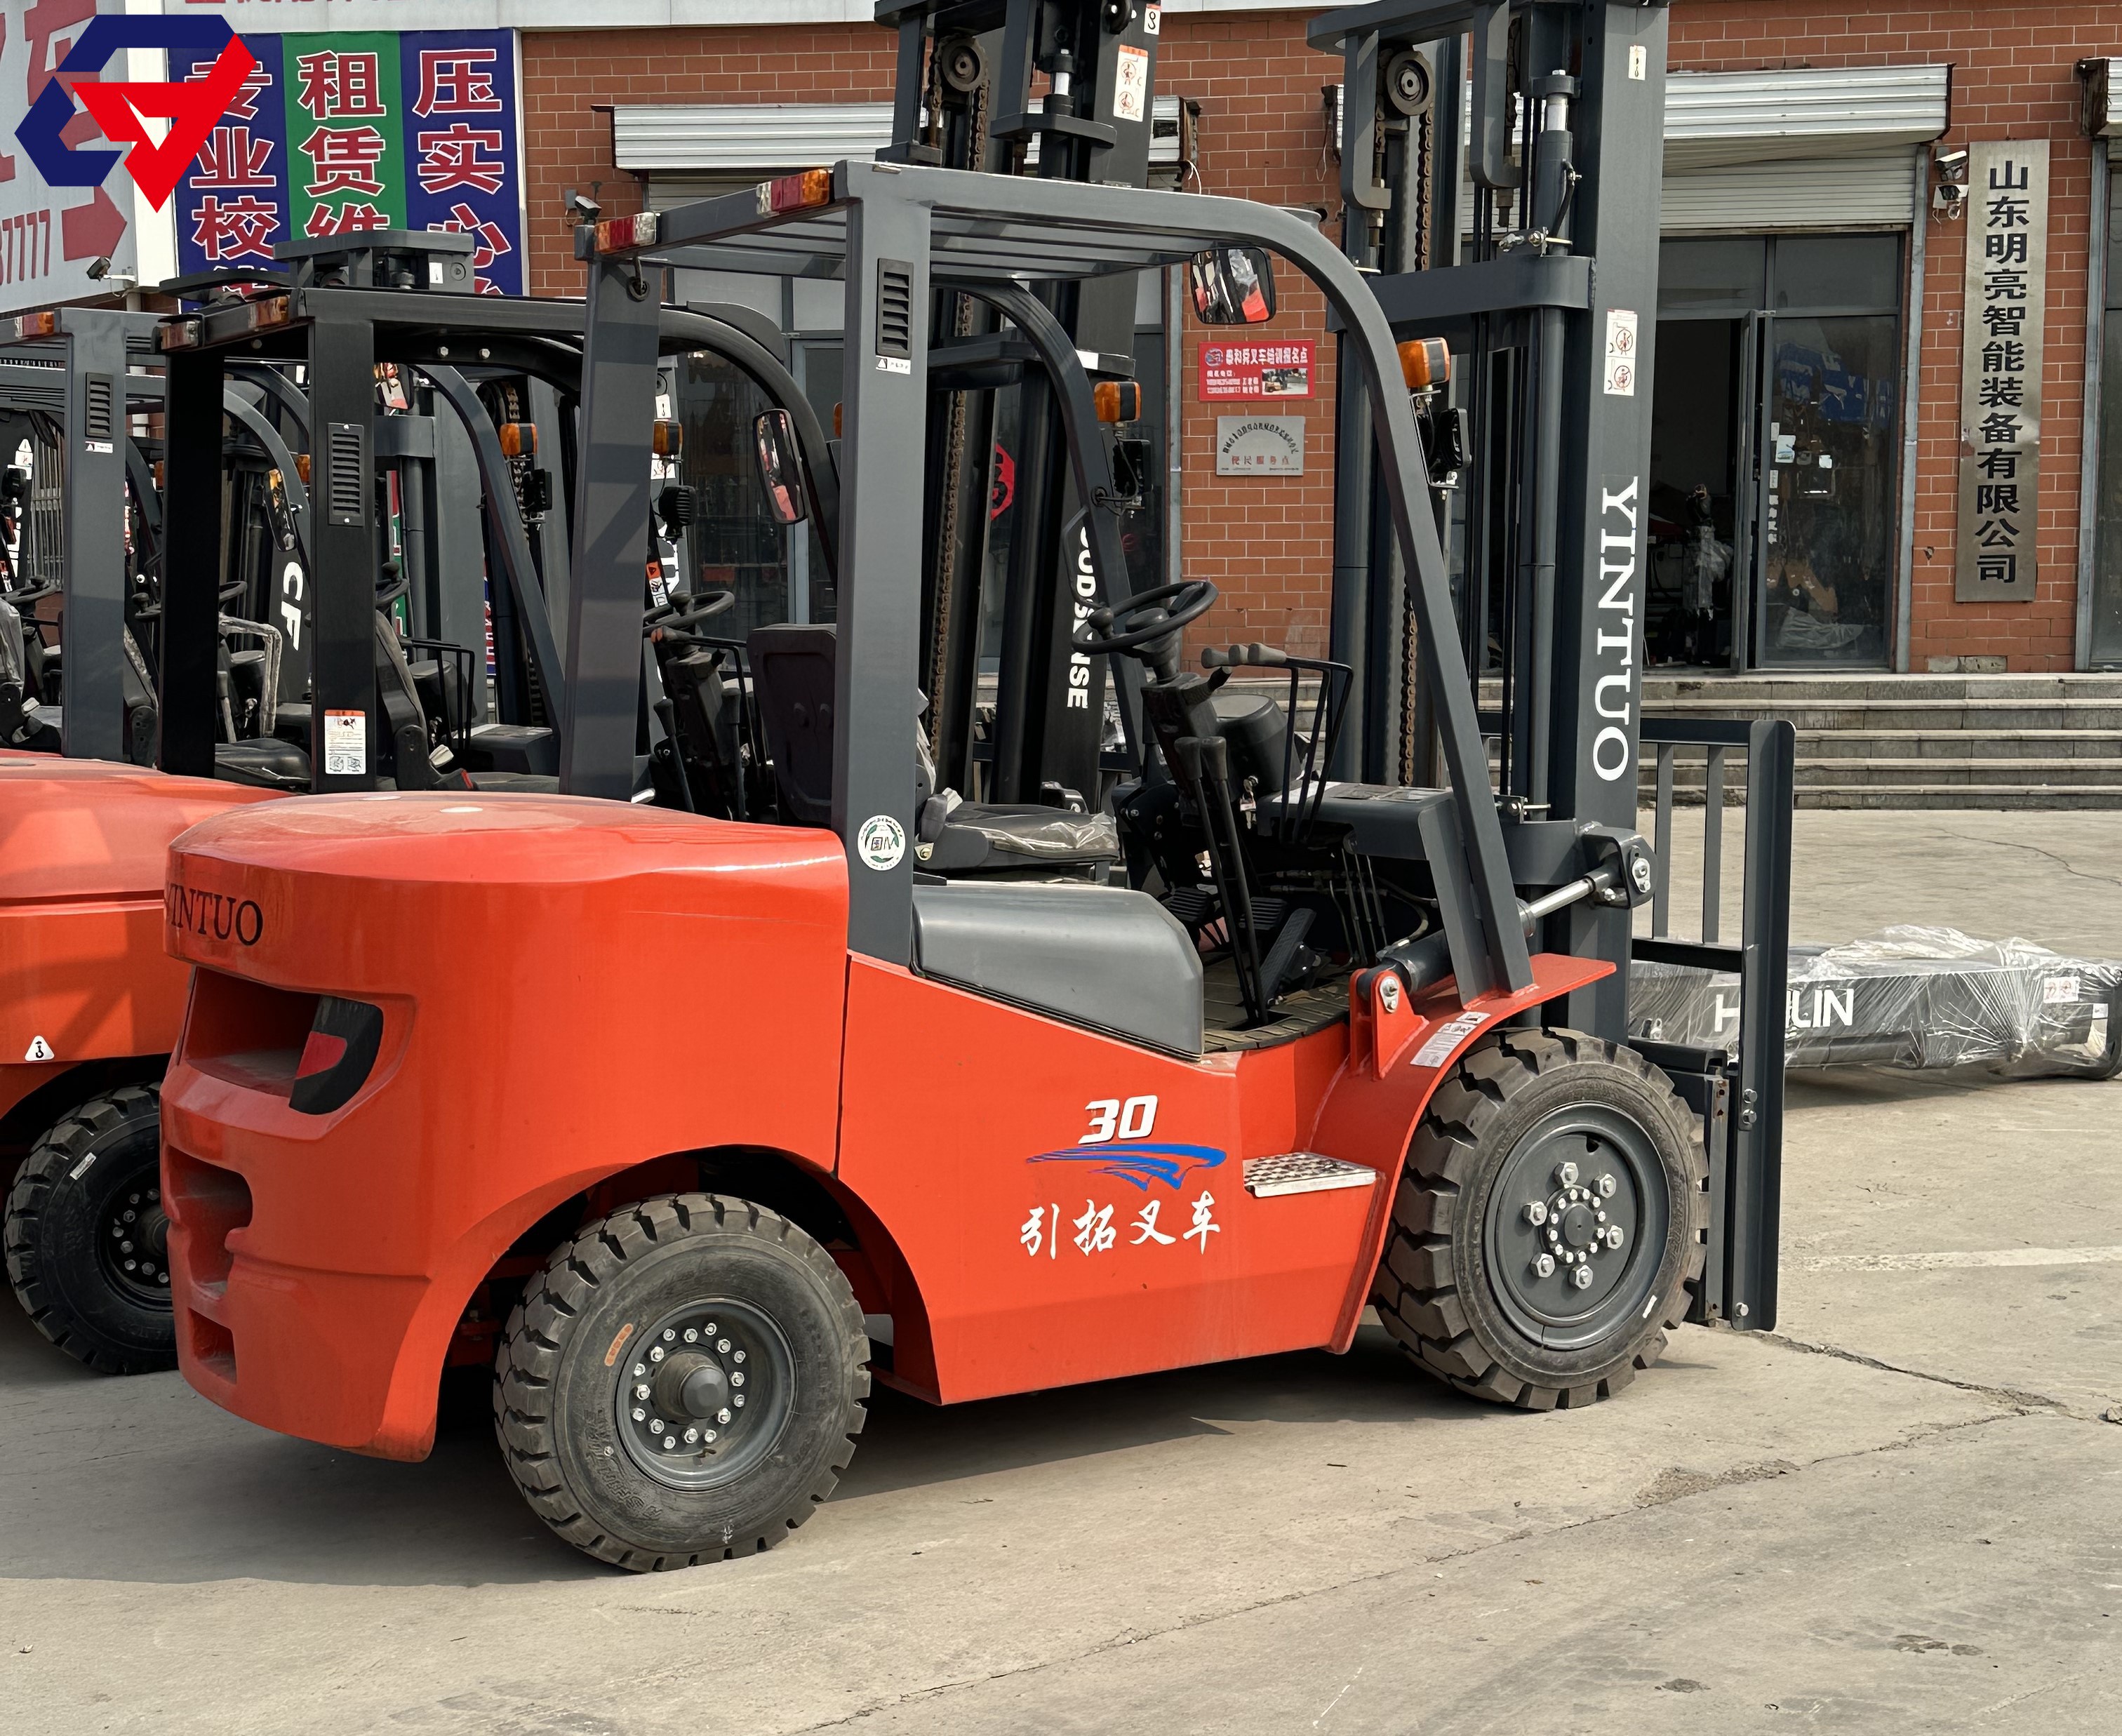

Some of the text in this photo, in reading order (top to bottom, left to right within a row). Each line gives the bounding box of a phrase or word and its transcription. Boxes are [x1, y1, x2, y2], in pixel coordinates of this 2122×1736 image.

[0, 208, 51, 286] 7777
[1975, 160, 2029, 584] 山东明亮智能装备有限公司
[1593, 476, 1639, 781] YINTUO
[1078, 1095, 1159, 1144] 30
[1020, 1190, 1221, 1260] 引拓叉车
